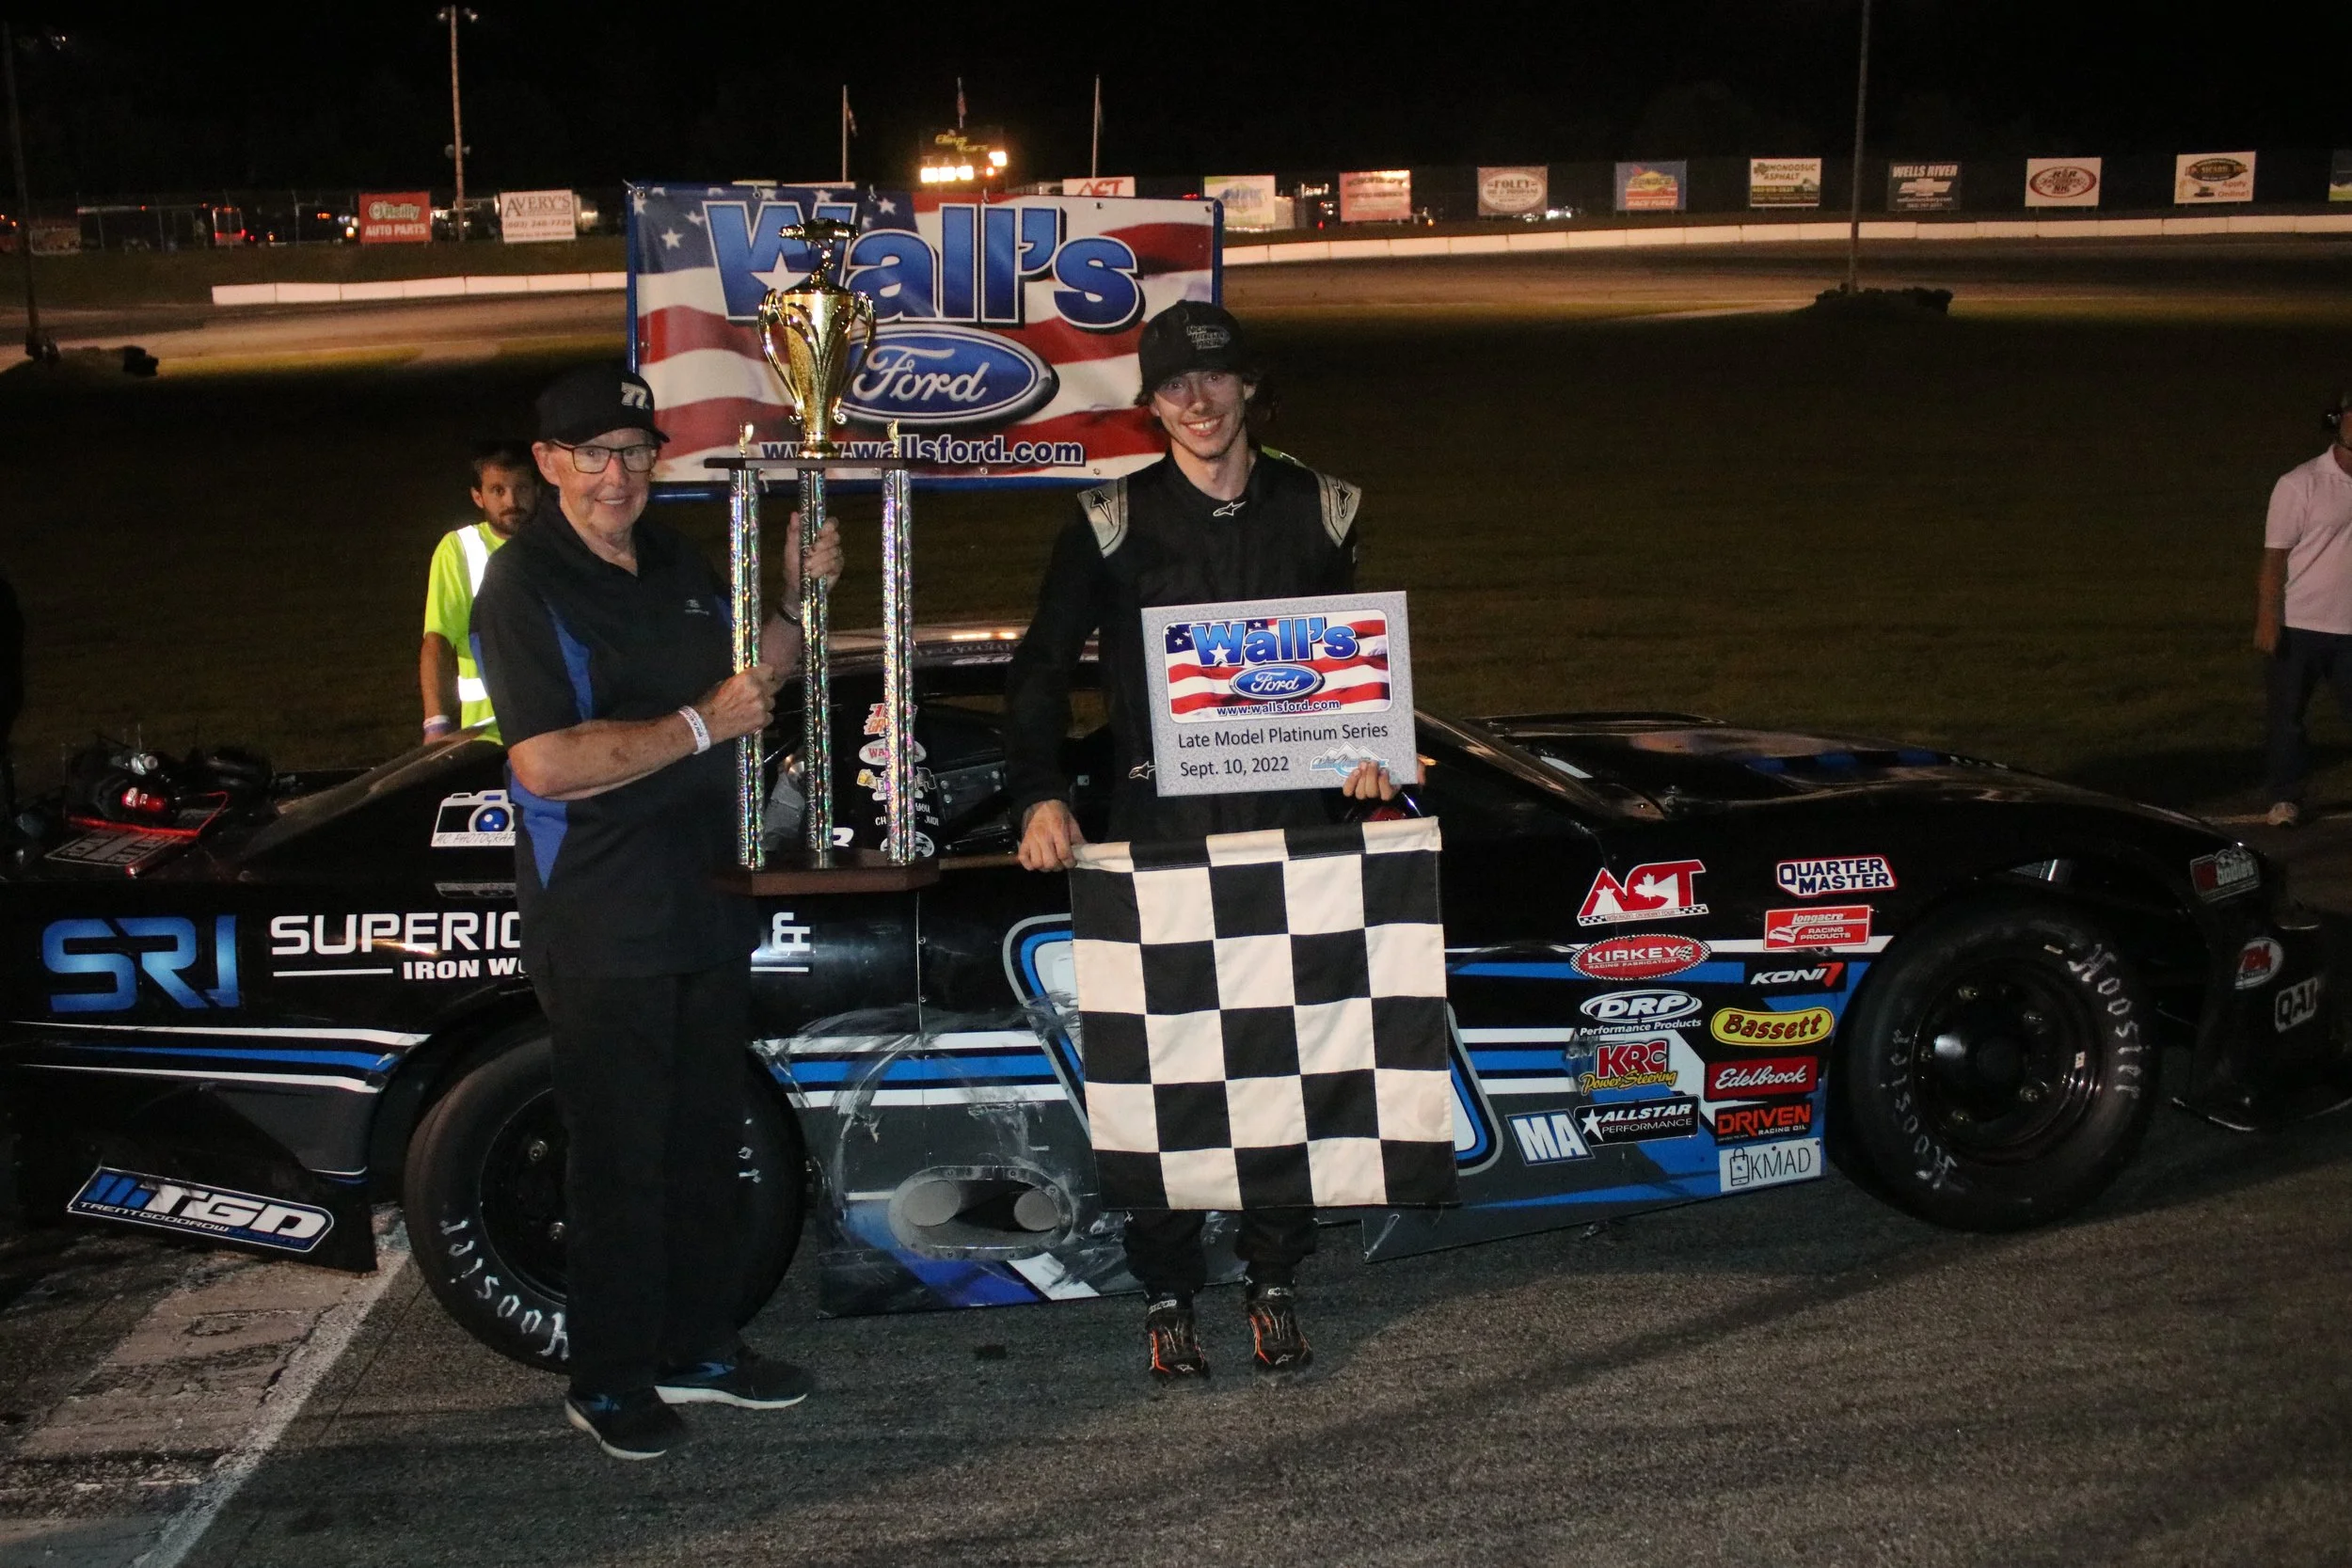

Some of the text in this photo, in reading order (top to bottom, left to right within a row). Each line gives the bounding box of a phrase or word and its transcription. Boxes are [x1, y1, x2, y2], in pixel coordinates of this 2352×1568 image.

[1764, 172, 1800, 181] ASPHALT
[1892, 165, 1959, 178] WELLS RIVER
[1494, 180, 1530, 188] FOLEY
[369, 200, 421, 221] O'Reilly
[505, 195, 571, 217] AVERY'S
[365, 223, 426, 237] AUTO PARTS
[702, 200, 1142, 329] Wall's
[852, 345, 989, 404] Ford
[621, 382, 647, 409] 77
[1191, 616, 1359, 667] Wall's
[1250, 671, 1300, 693] Ford
[1216, 699, 1341, 717] www.wallsford.com
[1178, 722, 1389, 749] Late Model Platinum Series
[1181, 761, 1219, 780] Sept.
[1224, 758, 1248, 777] 10,
[1252, 756, 1290, 774] 2022
[453, 832, 516, 845] PHOTOGRAP
[1779, 858, 1883, 885] QUARTER
[1579, 860, 1707, 917] ACT
[1799, 872, 1889, 895] MASTER
[1792, 912, 1844, 925] Longacre
[1800, 932, 1851, 941] PRODUCTS
[42, 914, 241, 1012] SRI
[1587, 946, 1680, 963] KIRKEY
[1622, 958, 1677, 967] FABRICATION
[403, 959, 480, 979] IRON
[1597, 995, 1689, 1018] DRP
[1580, 1019, 1702, 1037] Performance Products
[1723, 1013, 1822, 1039] Bassett
[1597, 1039, 1668, 1080] KRC
[1580, 1069, 1677, 1096] Power Steering
[1714, 1065, 1807, 1090] Edelbrock
[1600, 1103, 1692, 1123] ALLSTAR
[1717, 1103, 1811, 1137] DRIVEN
[1601, 1117, 1693, 1134] PERFORMANCE
[1757, 1126, 1790, 1136] RACING
[1512, 1114, 1589, 1162] MA
[1750, 1147, 1811, 1180] KMAD
[139, 1182, 326, 1240] TGD
